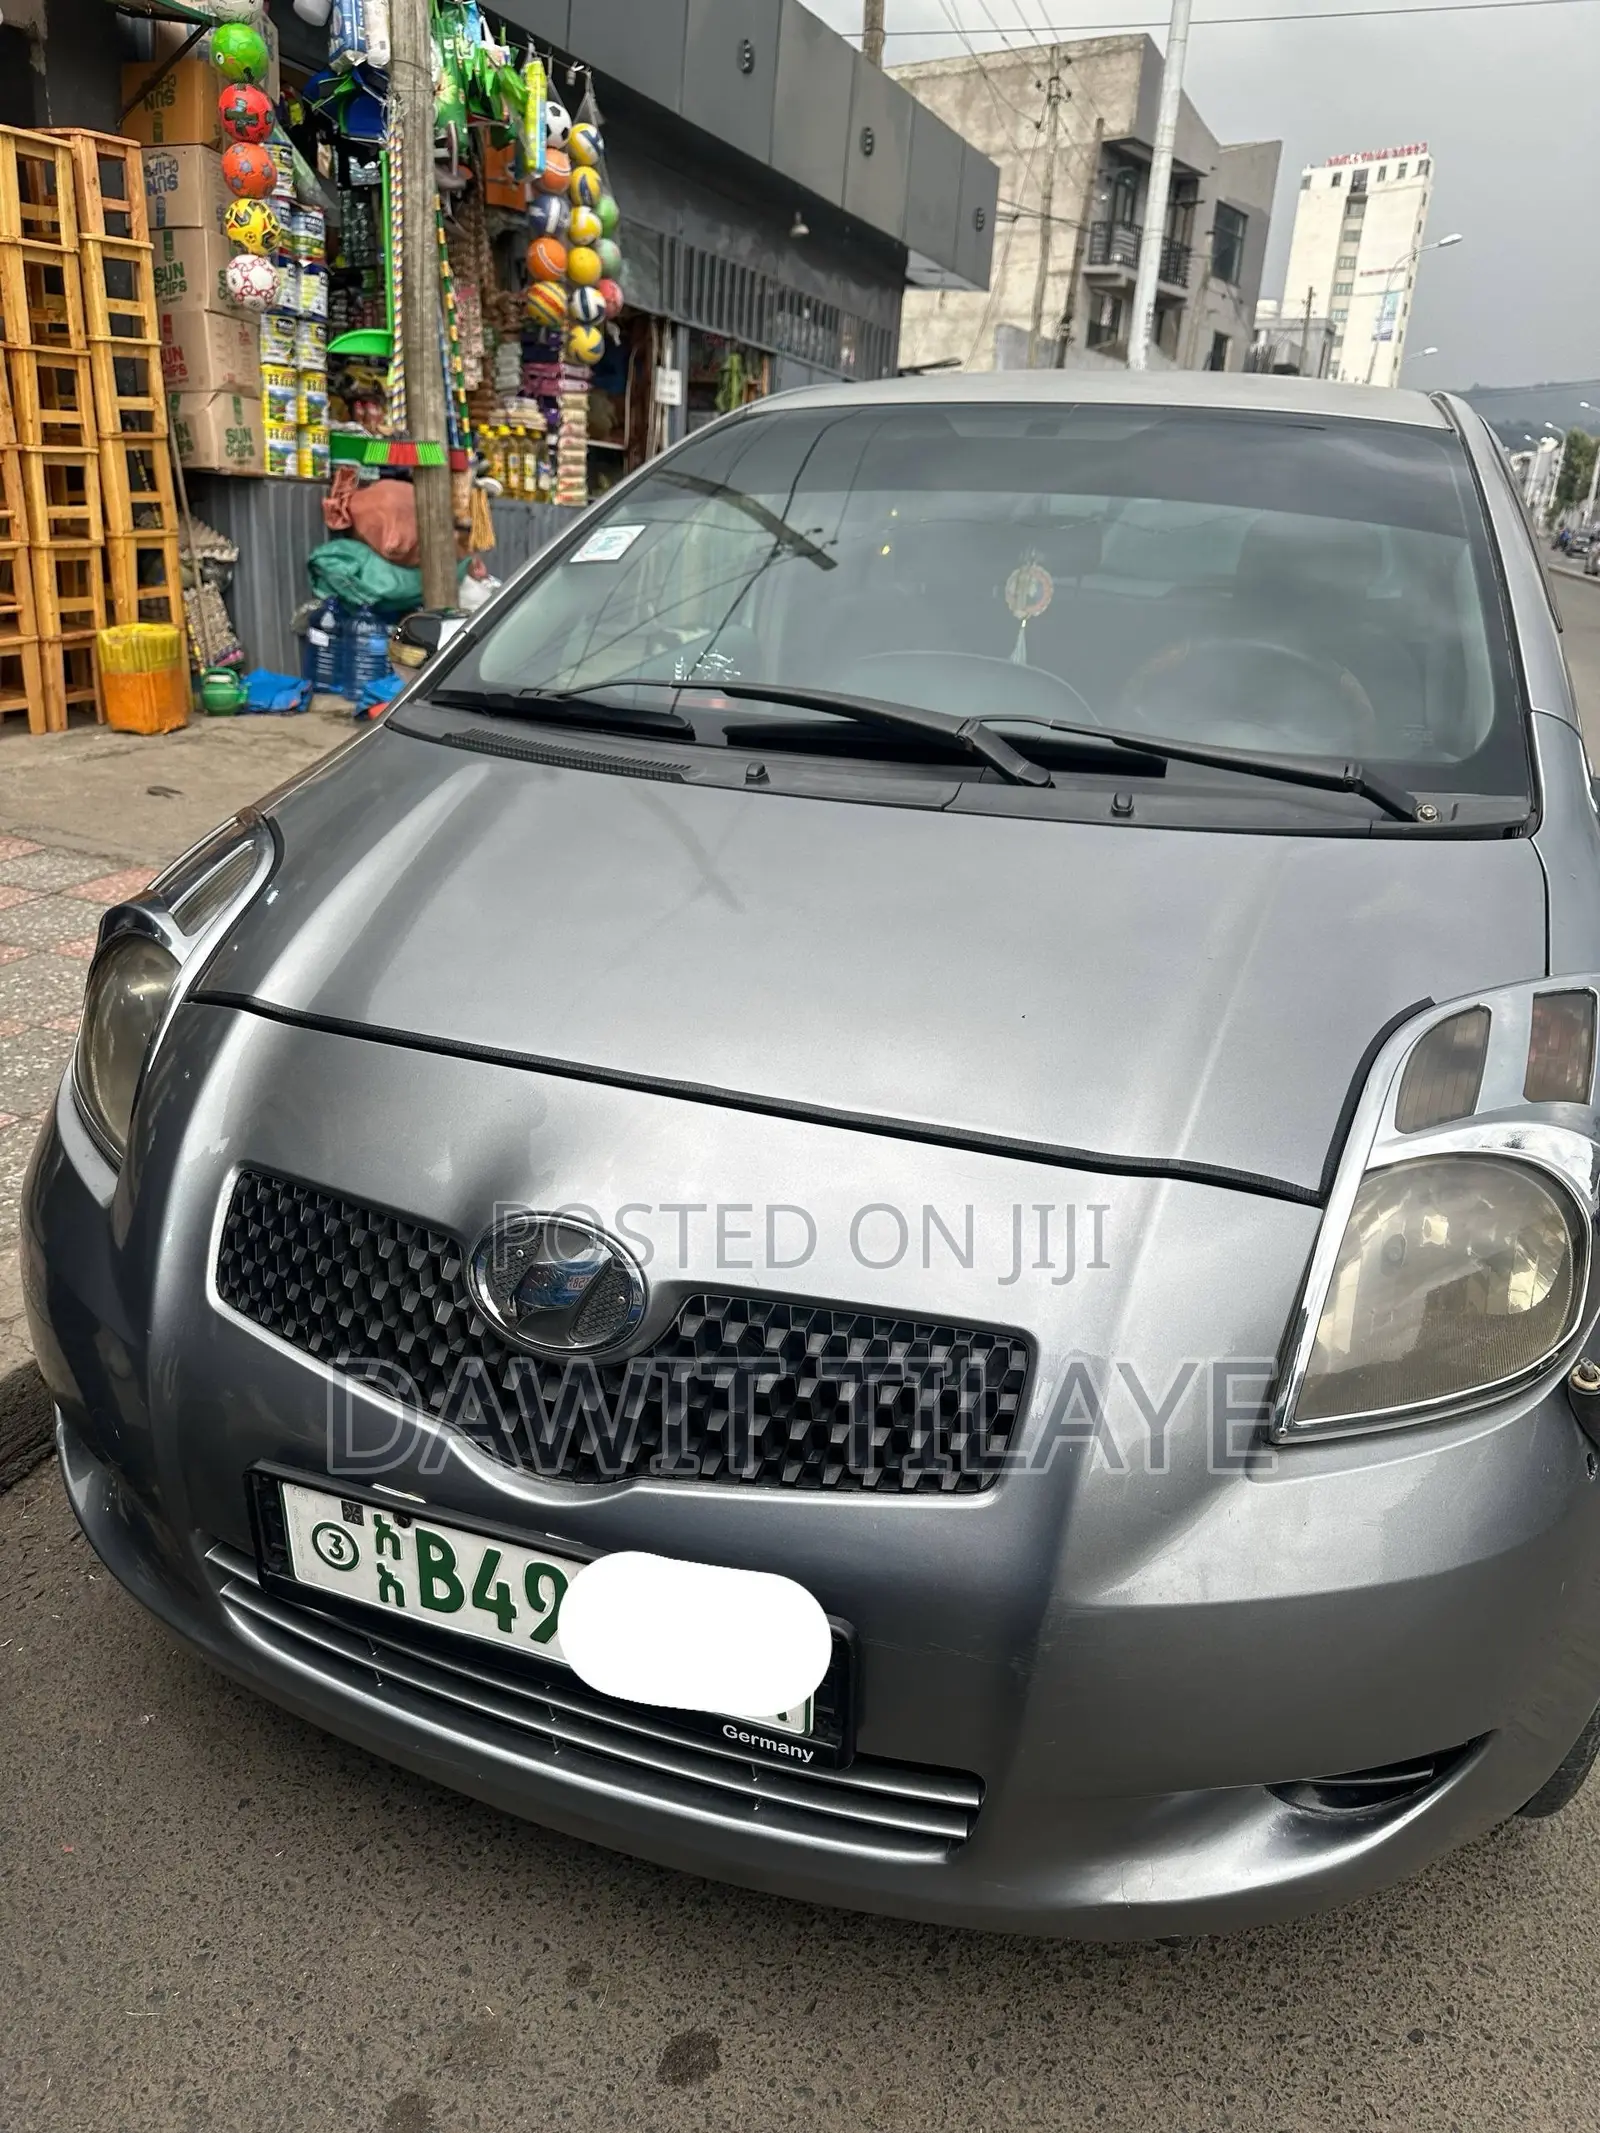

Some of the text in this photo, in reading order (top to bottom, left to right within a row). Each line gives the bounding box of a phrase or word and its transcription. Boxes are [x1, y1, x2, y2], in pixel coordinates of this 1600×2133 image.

[144, 89, 176, 112] SUN
[144, 159, 179, 178] CHIPS
[146, 174, 179, 196] SUN
[154, 261, 184, 283] SUN
[162, 345, 184, 364] UN
[225, 428, 252, 443] SUN
[225, 444, 255, 458] CHIPS
[415, 1527, 569, 1644] B49
[722, 1724, 814, 1763] Germany
